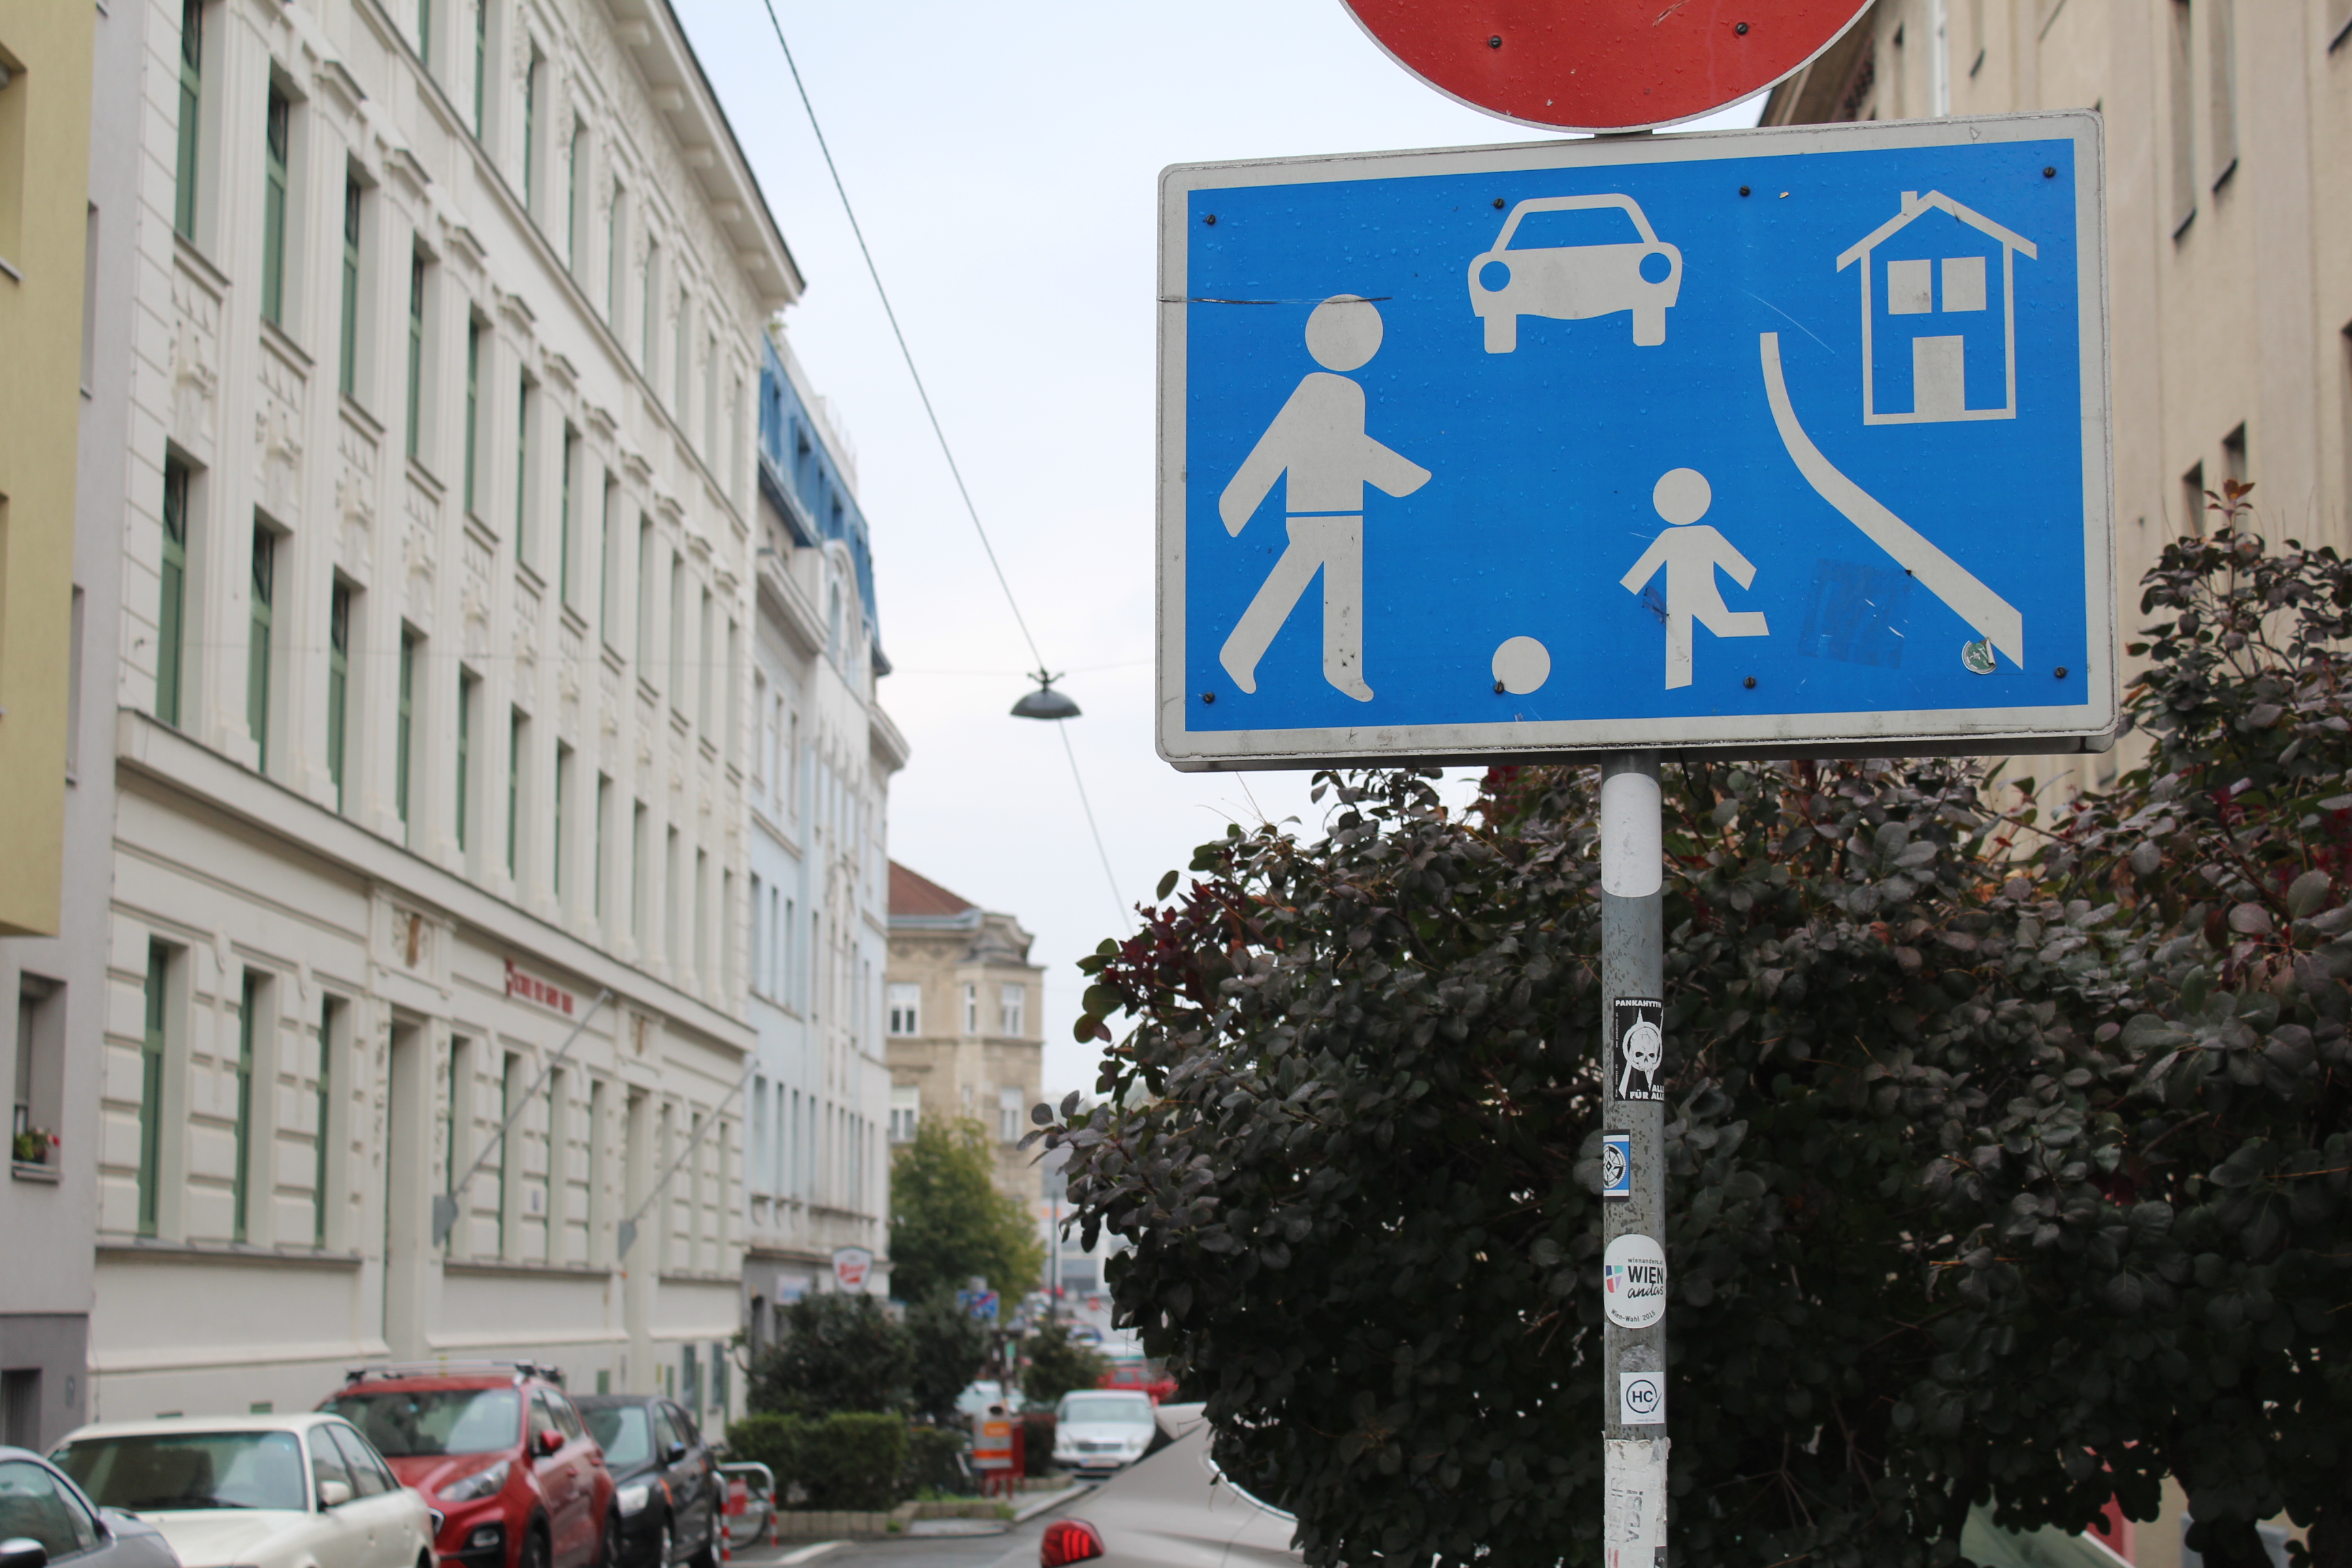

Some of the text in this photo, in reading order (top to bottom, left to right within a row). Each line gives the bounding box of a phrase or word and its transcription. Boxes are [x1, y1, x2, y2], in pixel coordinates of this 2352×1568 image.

[1629, 1089, 1649, 1100] FÜR
[1627, 1265, 1664, 1284] WIEN
[1611, 1308, 1656, 1322] Wien-Wahl 2015
[1632, 1390, 1653, 1403] HC
